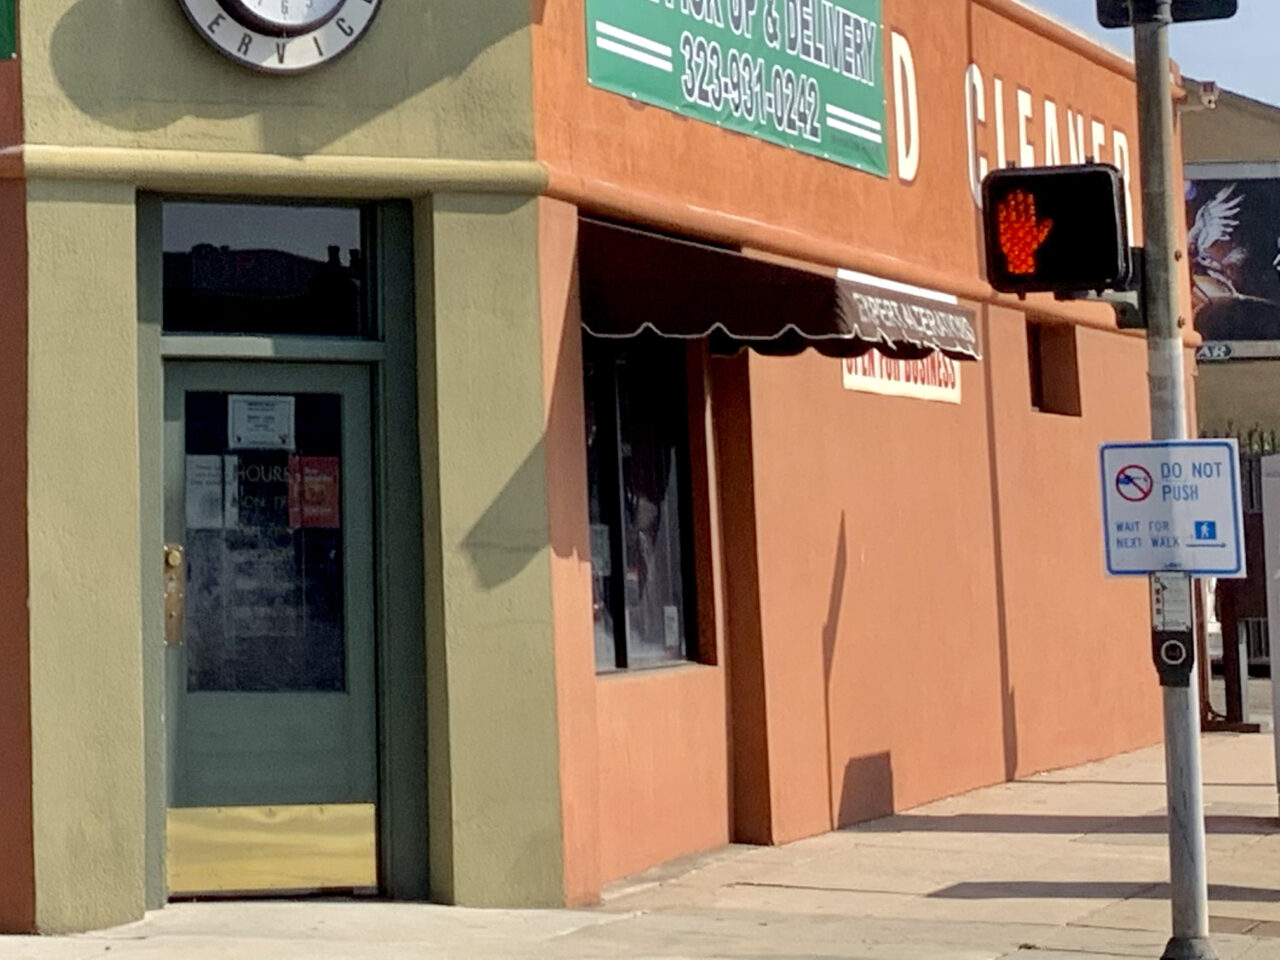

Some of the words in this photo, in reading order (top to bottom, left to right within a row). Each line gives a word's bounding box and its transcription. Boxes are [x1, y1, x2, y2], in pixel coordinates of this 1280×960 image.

[280, 0, 289, 16] 6
[680, 31, 821, 142] 323-931-0242
[1160, 462, 1182, 479] DO
[1192, 462, 1222, 478] NOT
[1162, 484, 1199, 502] PUSH
[1115, 520, 1141, 532] WAIT
[1148, 521, 1170, 532] FOR
